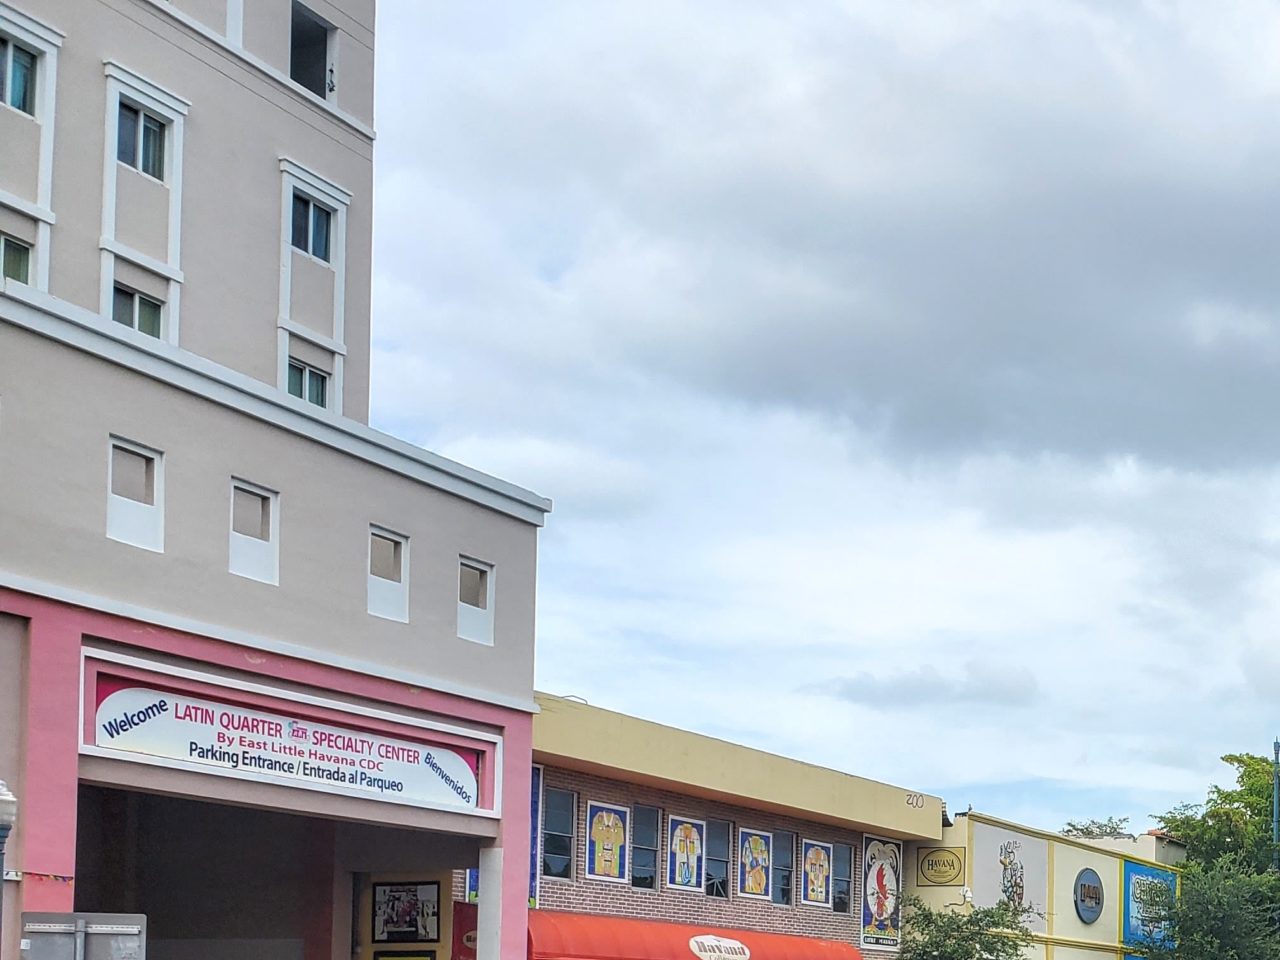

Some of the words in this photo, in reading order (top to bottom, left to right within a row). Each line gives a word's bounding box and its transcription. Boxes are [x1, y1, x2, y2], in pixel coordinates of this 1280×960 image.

[103, 699, 169, 739] Welcome
[174, 702, 215, 726] LATIN
[219, 711, 283, 739] QUARTER
[312, 730, 374, 756] SPECIALTY
[378, 743, 420, 765] CENTER
[189, 741, 239, 768] Parking
[242, 751, 294, 774] Entrance
[303, 761, 346, 783] Entrada
[348, 770, 358, 785] al
[360, 772, 403, 792] Parqueo
[217, 732, 235, 747] By
[239, 735, 268, 751] East
[271, 744, 305, 758] Little
[309, 749, 356, 766] Havana
[359, 758, 384, 772] CDC
[424, 752, 472, 804] Bienvenidos
[927, 859, 955, 870] HAVANA
[694, 940, 746, 956] Havana
